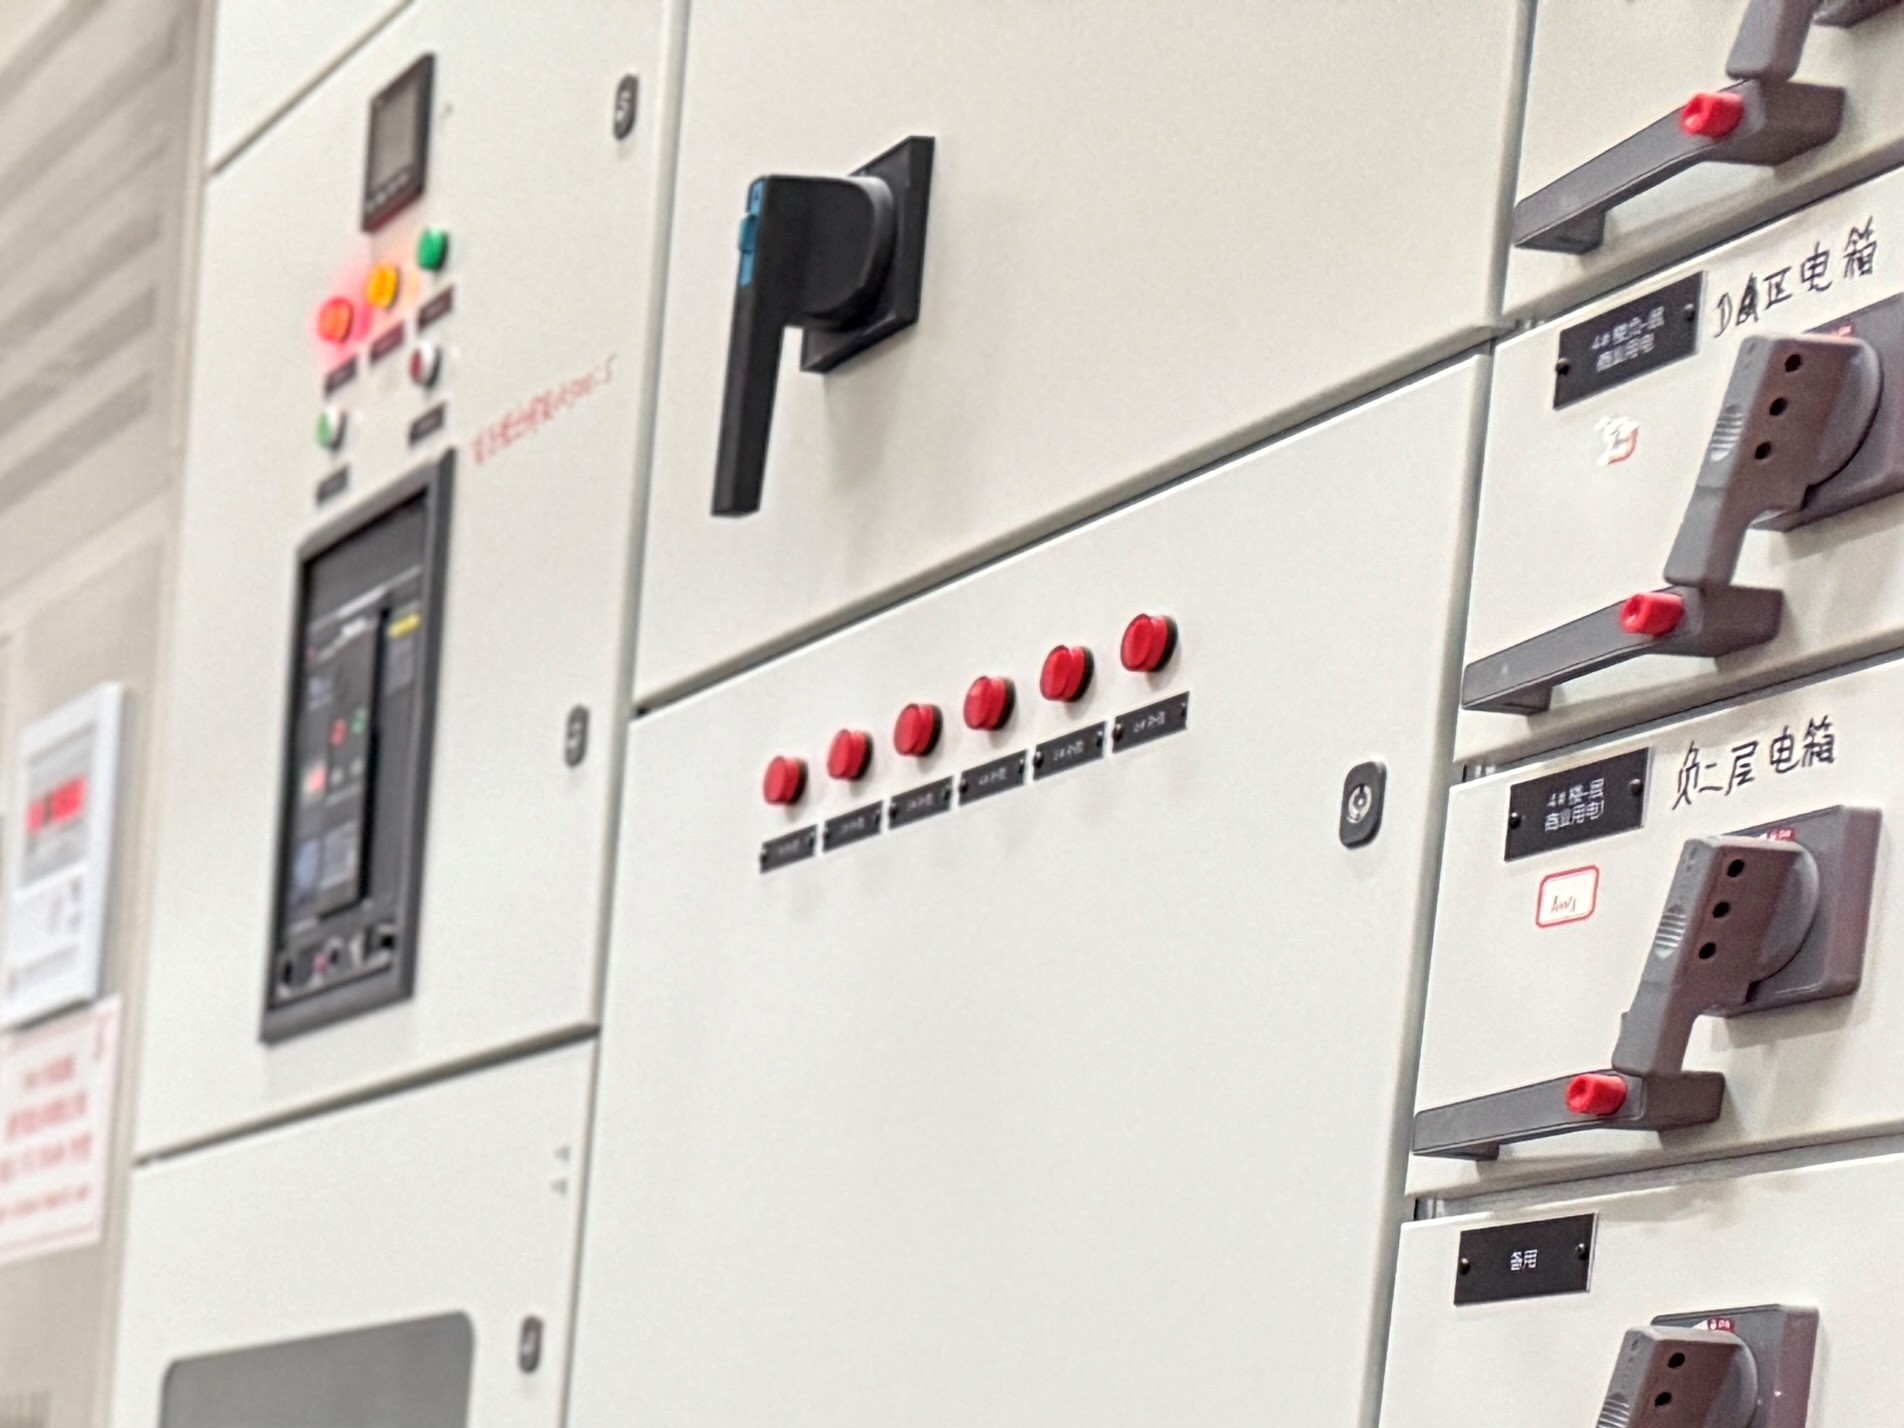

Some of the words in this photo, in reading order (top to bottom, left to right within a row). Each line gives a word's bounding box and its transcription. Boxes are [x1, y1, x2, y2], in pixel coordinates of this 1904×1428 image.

[1672, 715, 1835, 810] 负二层电箱
